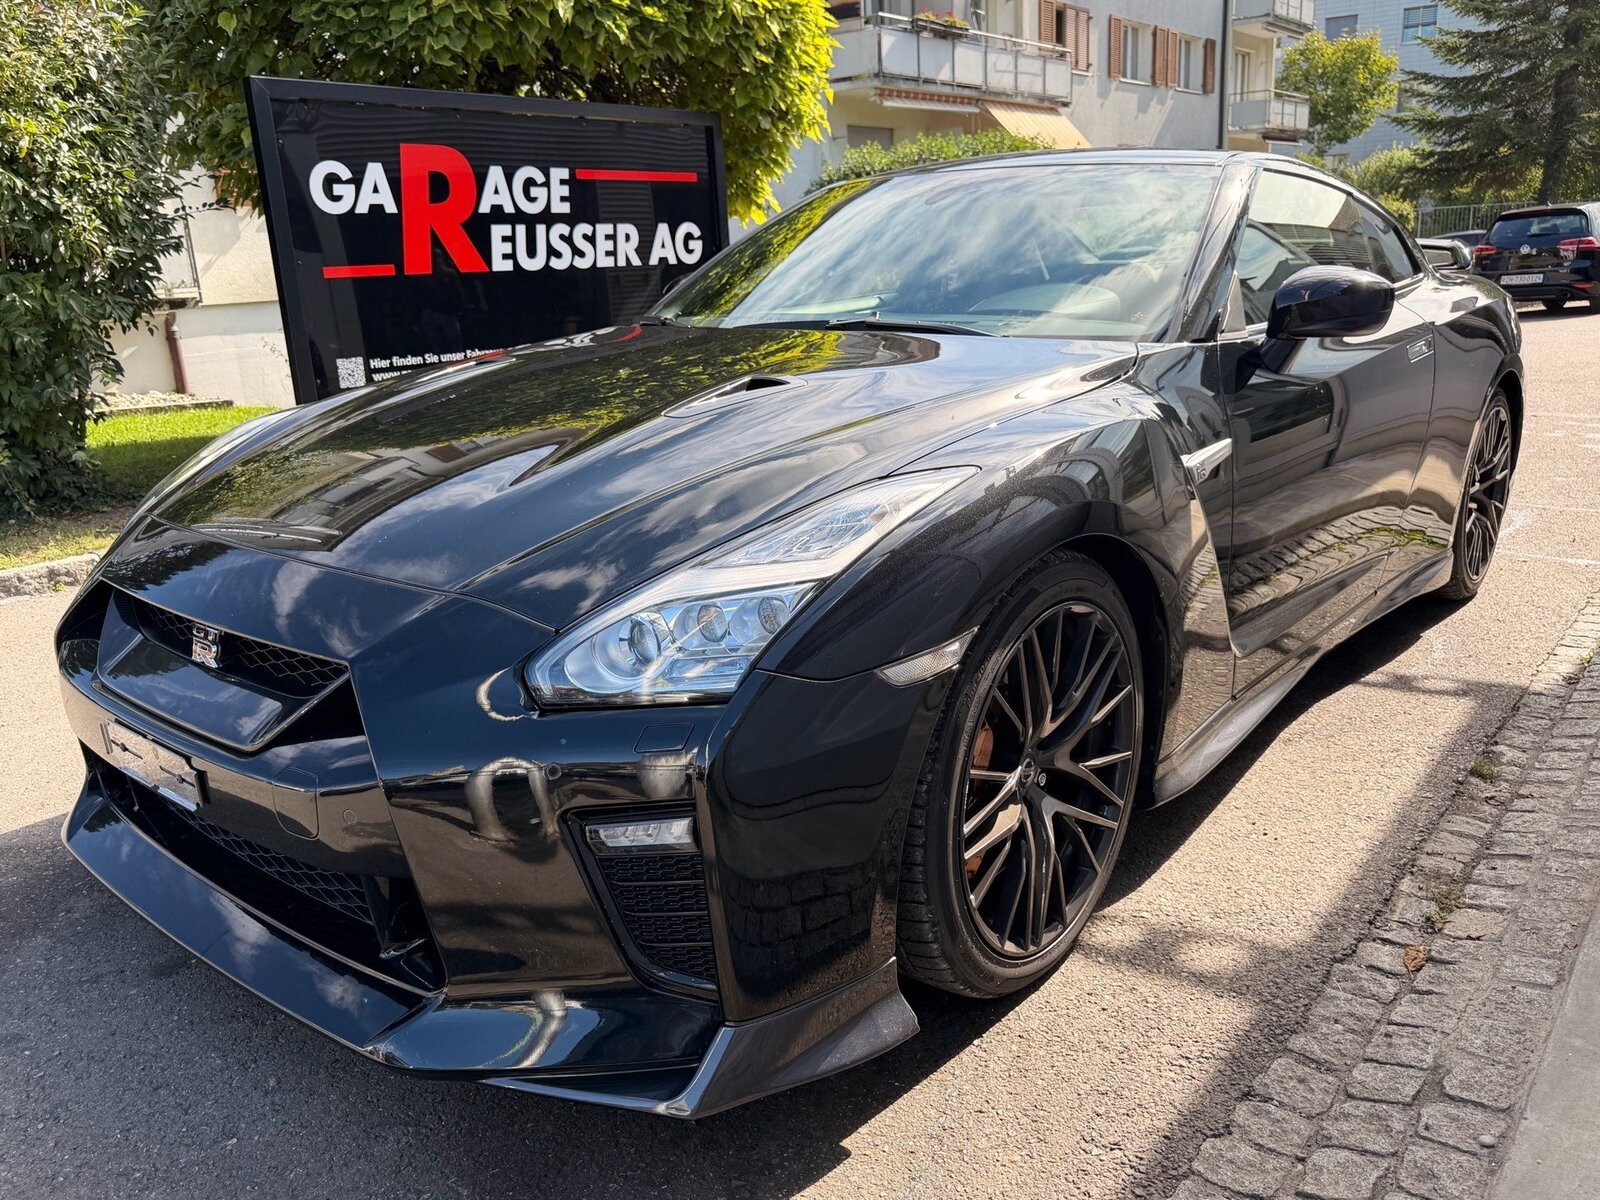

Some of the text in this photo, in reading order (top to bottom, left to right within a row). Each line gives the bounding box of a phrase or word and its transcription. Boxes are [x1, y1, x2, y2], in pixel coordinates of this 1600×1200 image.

[308, 142, 571, 275] GARAGE
[649, 222, 704, 266] AG
[370, 359, 390, 369] Hier
[392, 355, 423, 366] finden
[424, 353, 439, 363] Sie
[441, 351, 465, 361] unser
